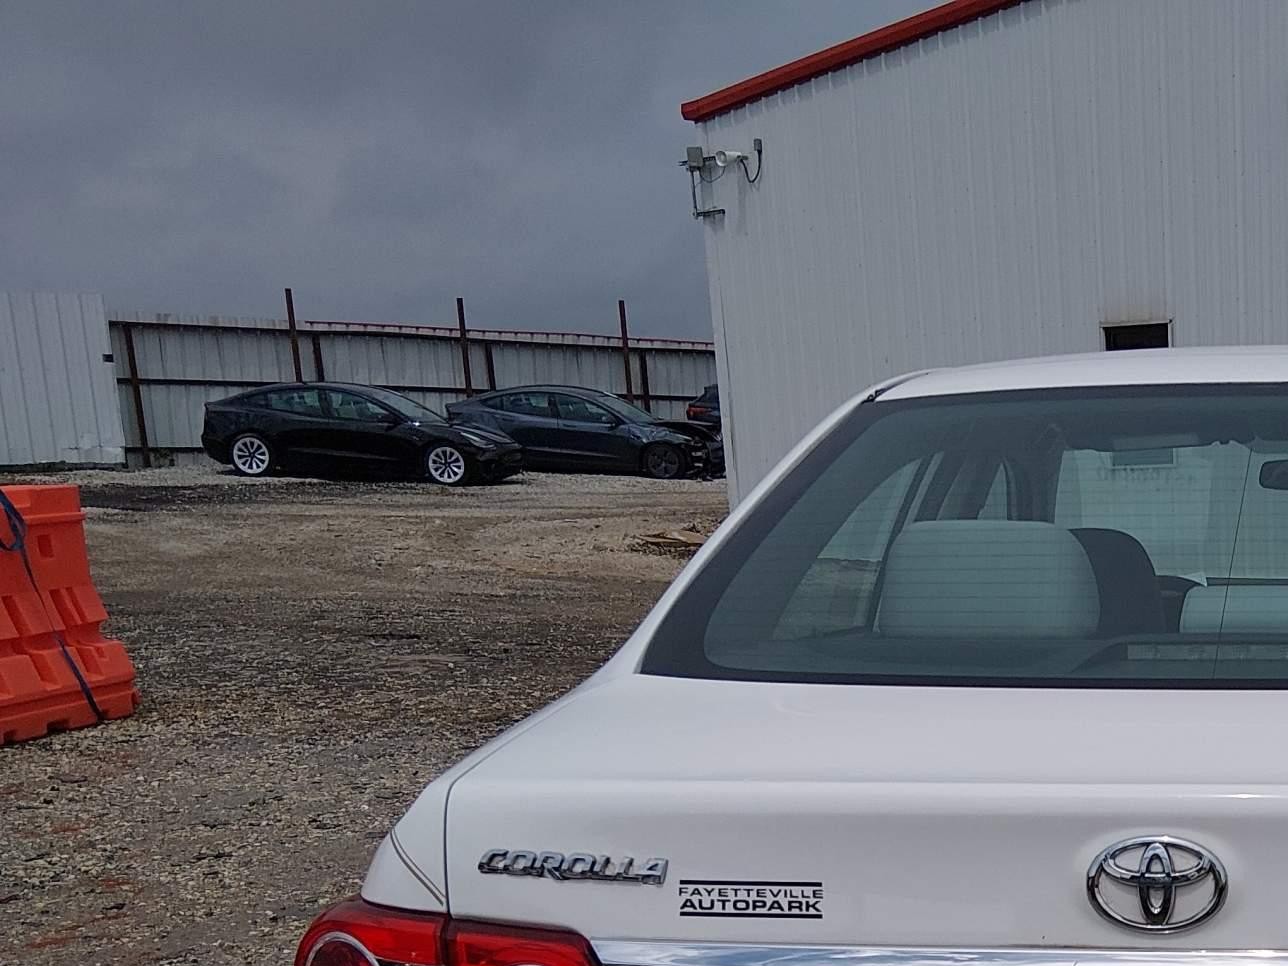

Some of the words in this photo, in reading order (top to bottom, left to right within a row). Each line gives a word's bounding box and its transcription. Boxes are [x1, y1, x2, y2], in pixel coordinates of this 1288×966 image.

[478, 848, 669, 887] COROLLA
[678, 887, 824, 899] FAYETTEVILLE
[679, 898, 822, 913] AUTOPARK
